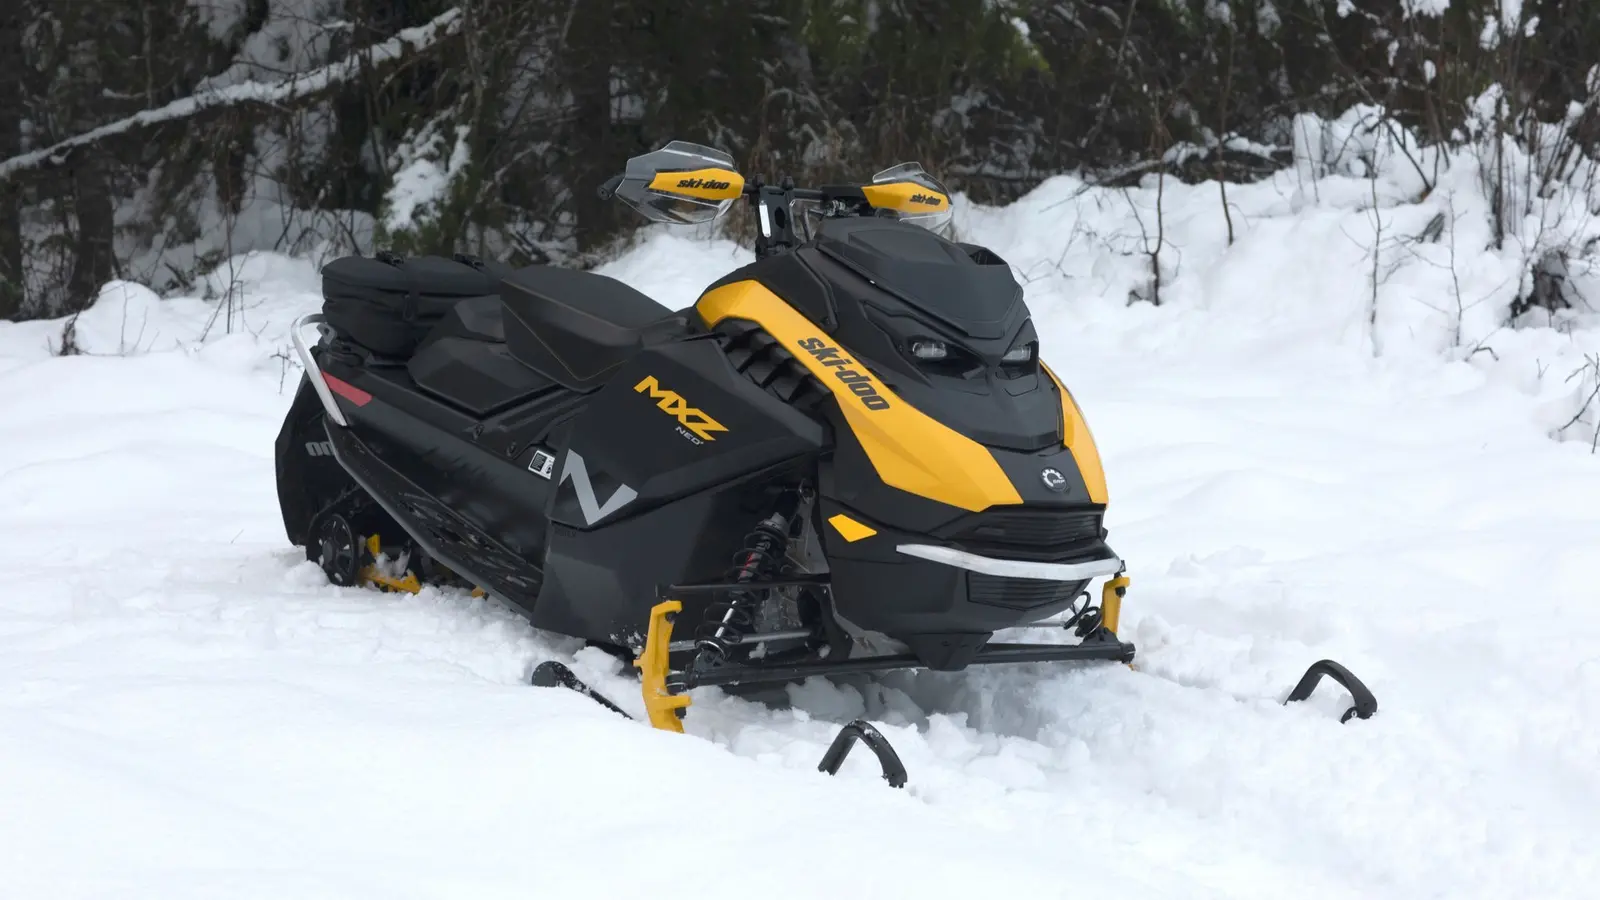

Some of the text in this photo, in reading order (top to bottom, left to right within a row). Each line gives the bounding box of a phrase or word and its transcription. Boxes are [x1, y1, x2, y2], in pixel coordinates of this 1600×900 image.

[677, 178, 730, 190] ski-doo
[797, 337, 891, 411] ski-doo
[633, 375, 730, 441] MXZ
